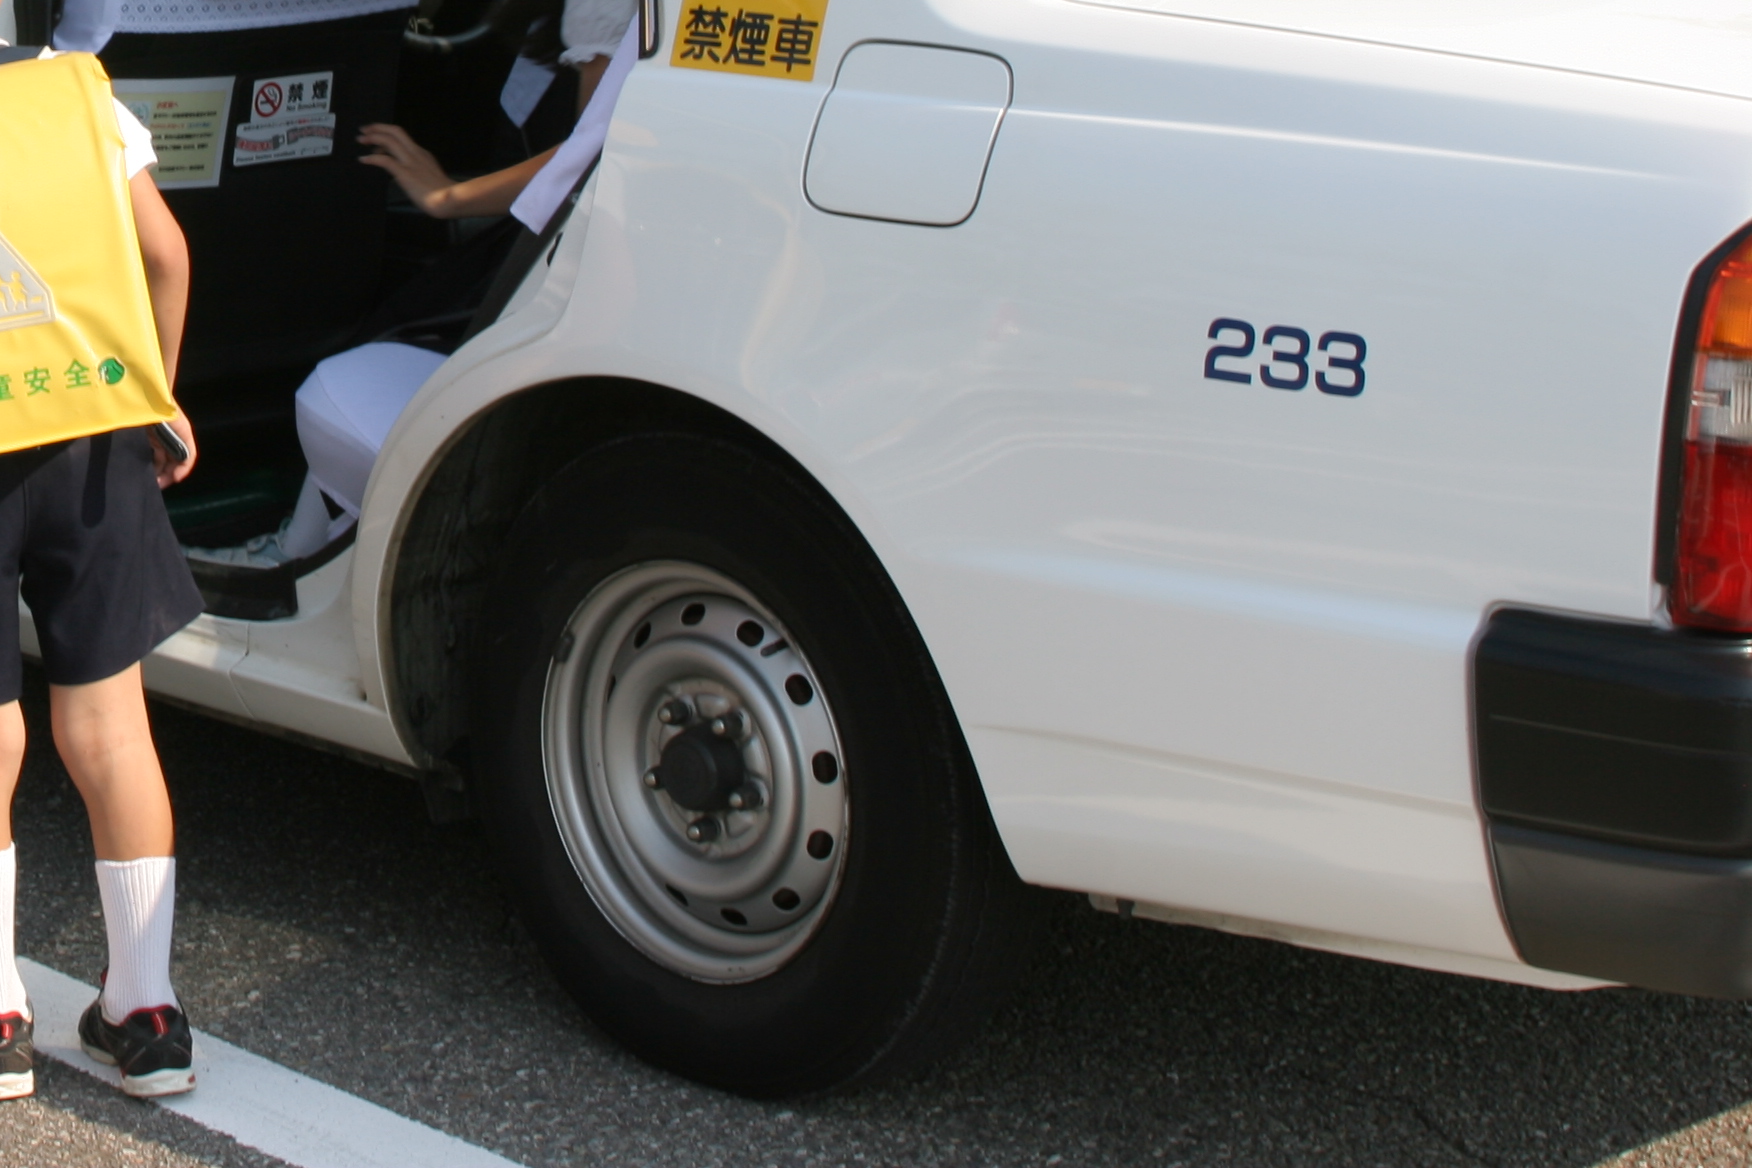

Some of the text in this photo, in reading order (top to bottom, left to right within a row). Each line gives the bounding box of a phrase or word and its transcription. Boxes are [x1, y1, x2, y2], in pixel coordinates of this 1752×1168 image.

[680, 3, 819, 74] 禁煙車
[287, 79, 329, 103] 禁煙
[1203, 316, 1368, 399] 233
